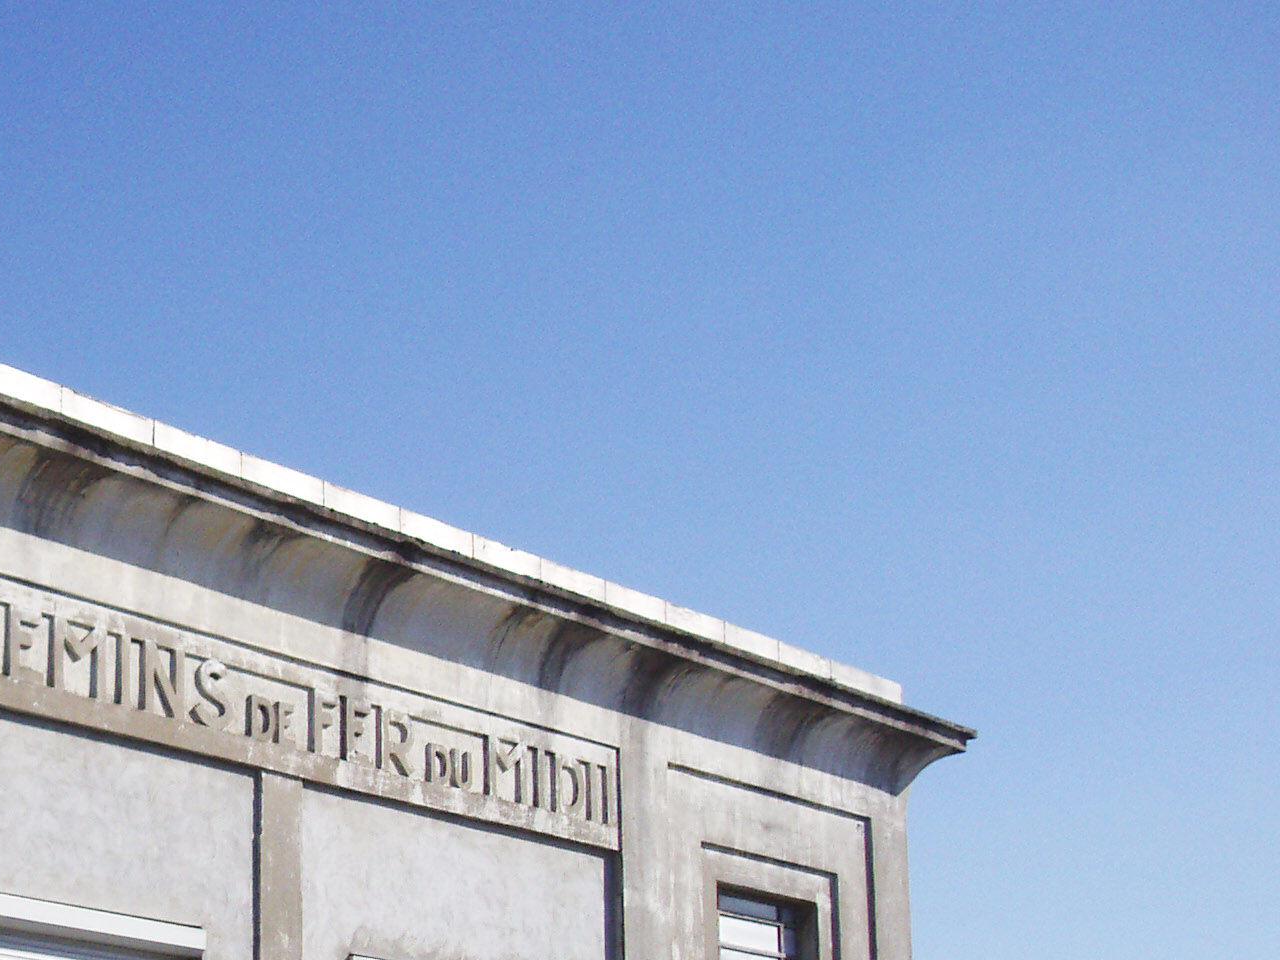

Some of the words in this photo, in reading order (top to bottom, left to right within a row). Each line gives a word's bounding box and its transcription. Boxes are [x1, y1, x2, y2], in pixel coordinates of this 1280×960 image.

[246, 694, 295, 744] DE
[310, 688, 416, 778] FER
[425, 742, 473, 789] DU
